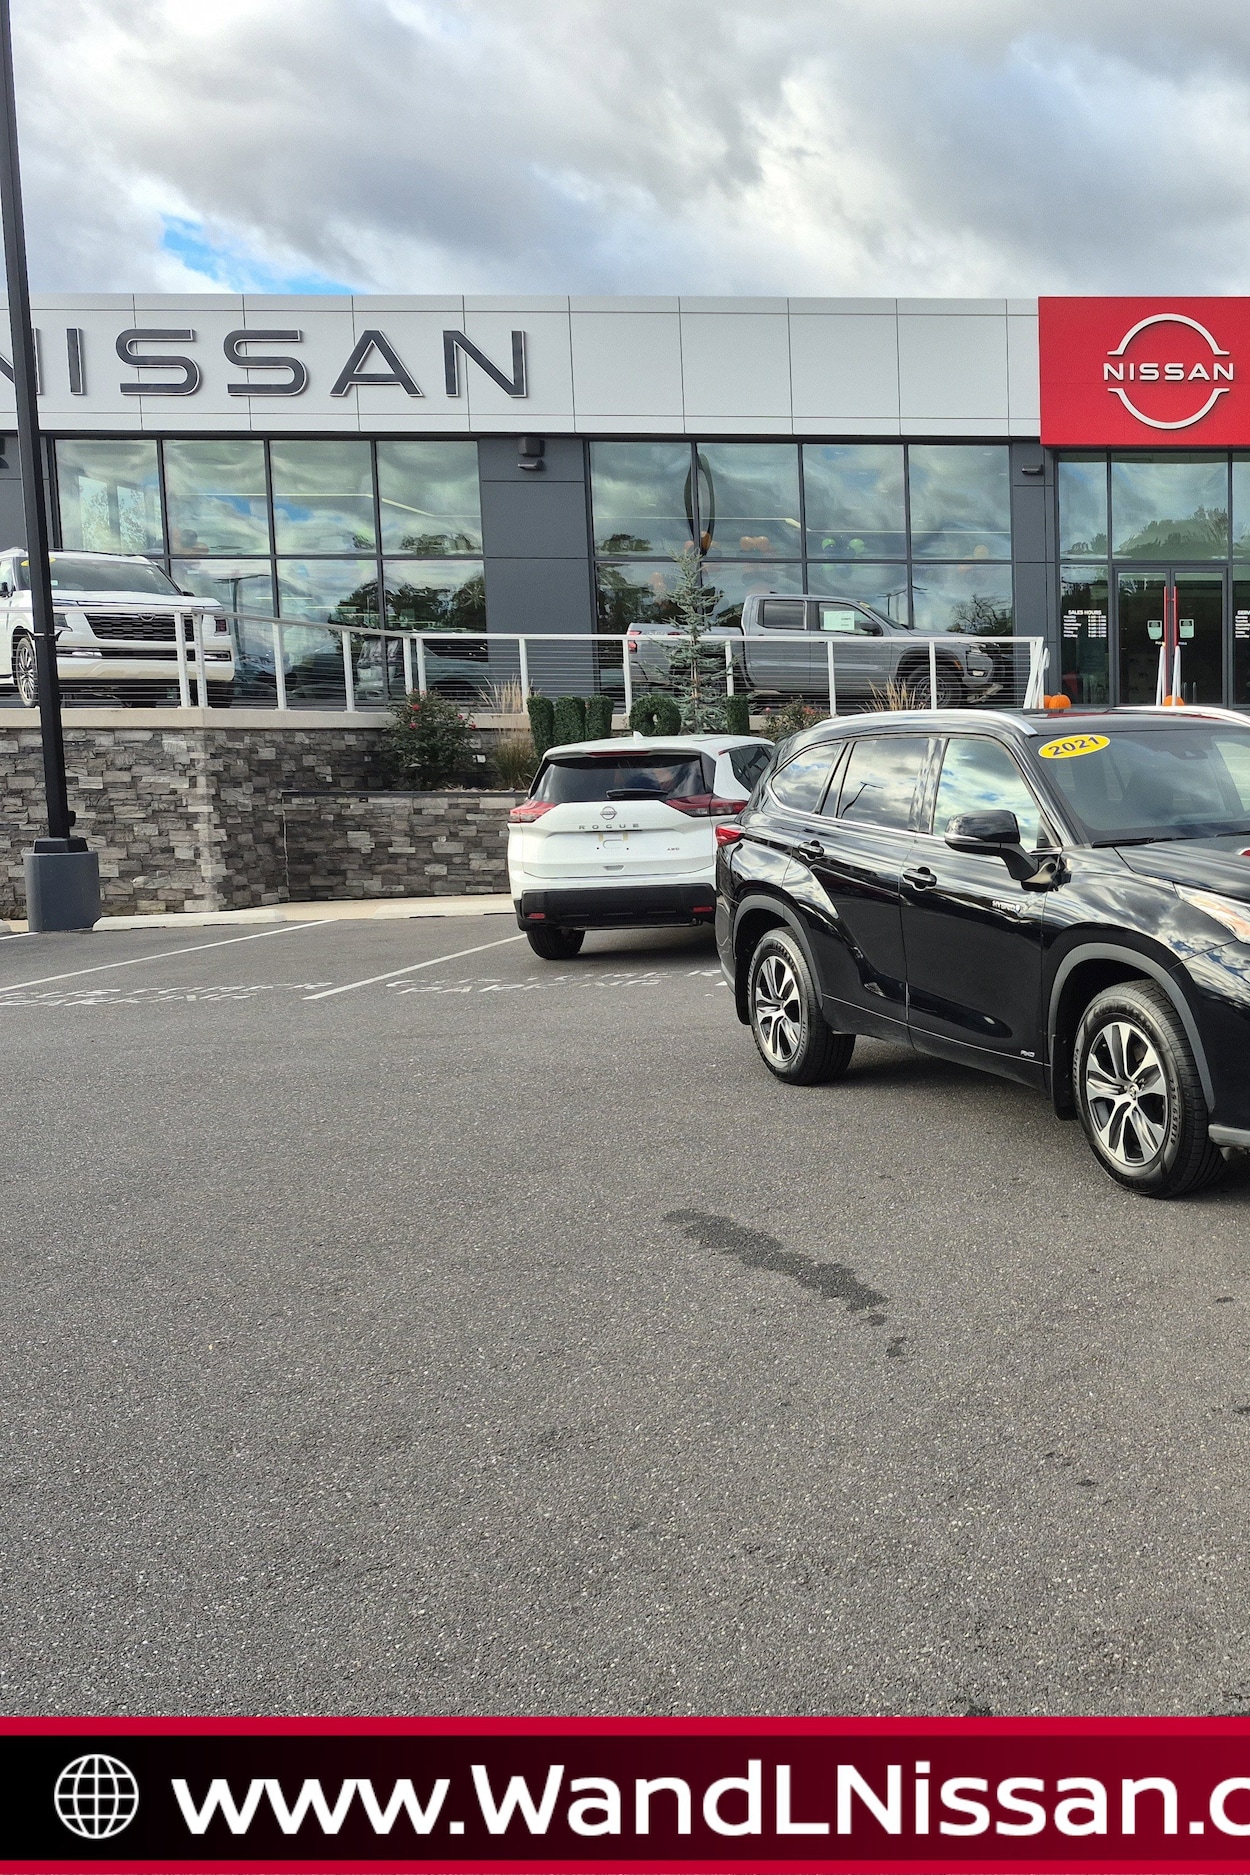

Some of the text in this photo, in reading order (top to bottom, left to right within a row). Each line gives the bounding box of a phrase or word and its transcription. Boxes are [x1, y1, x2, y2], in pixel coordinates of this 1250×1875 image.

[0, 328, 527, 398] ISSAN
[1103, 362, 1234, 382] NISSAN
[1048, 736, 1100, 756] 2021
